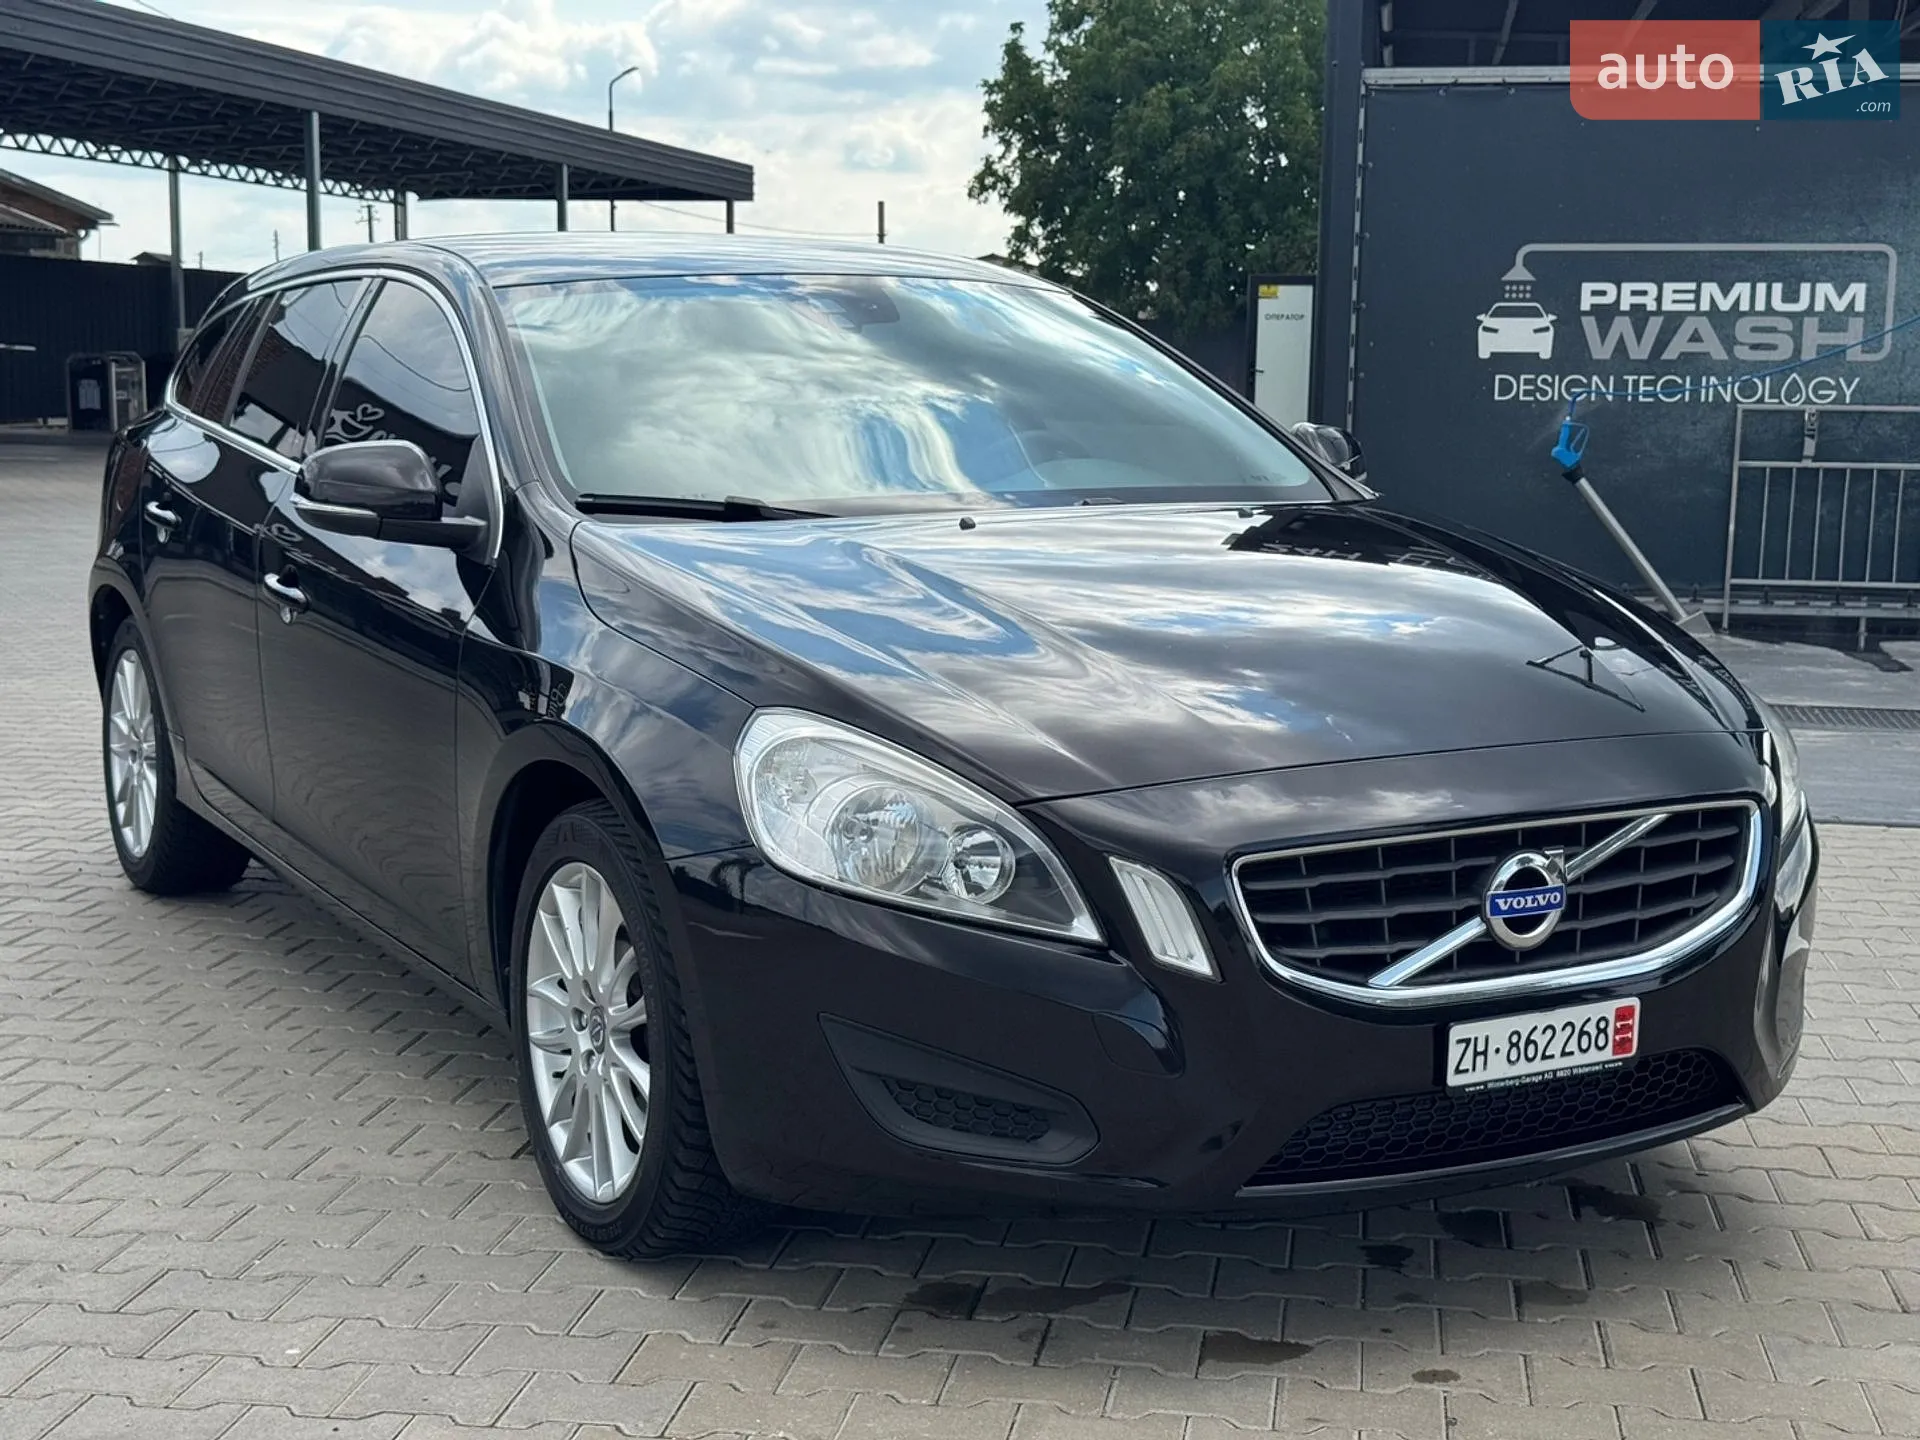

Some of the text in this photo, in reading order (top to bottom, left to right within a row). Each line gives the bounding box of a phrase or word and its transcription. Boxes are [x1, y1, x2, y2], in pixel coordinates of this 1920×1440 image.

[1580, 282, 1867, 313] PREMIUM
[1580, 315, 1866, 361] WASH
[1493, 374, 1614, 402] DESIGN
[1495, 892, 1561, 910] VOLVO
